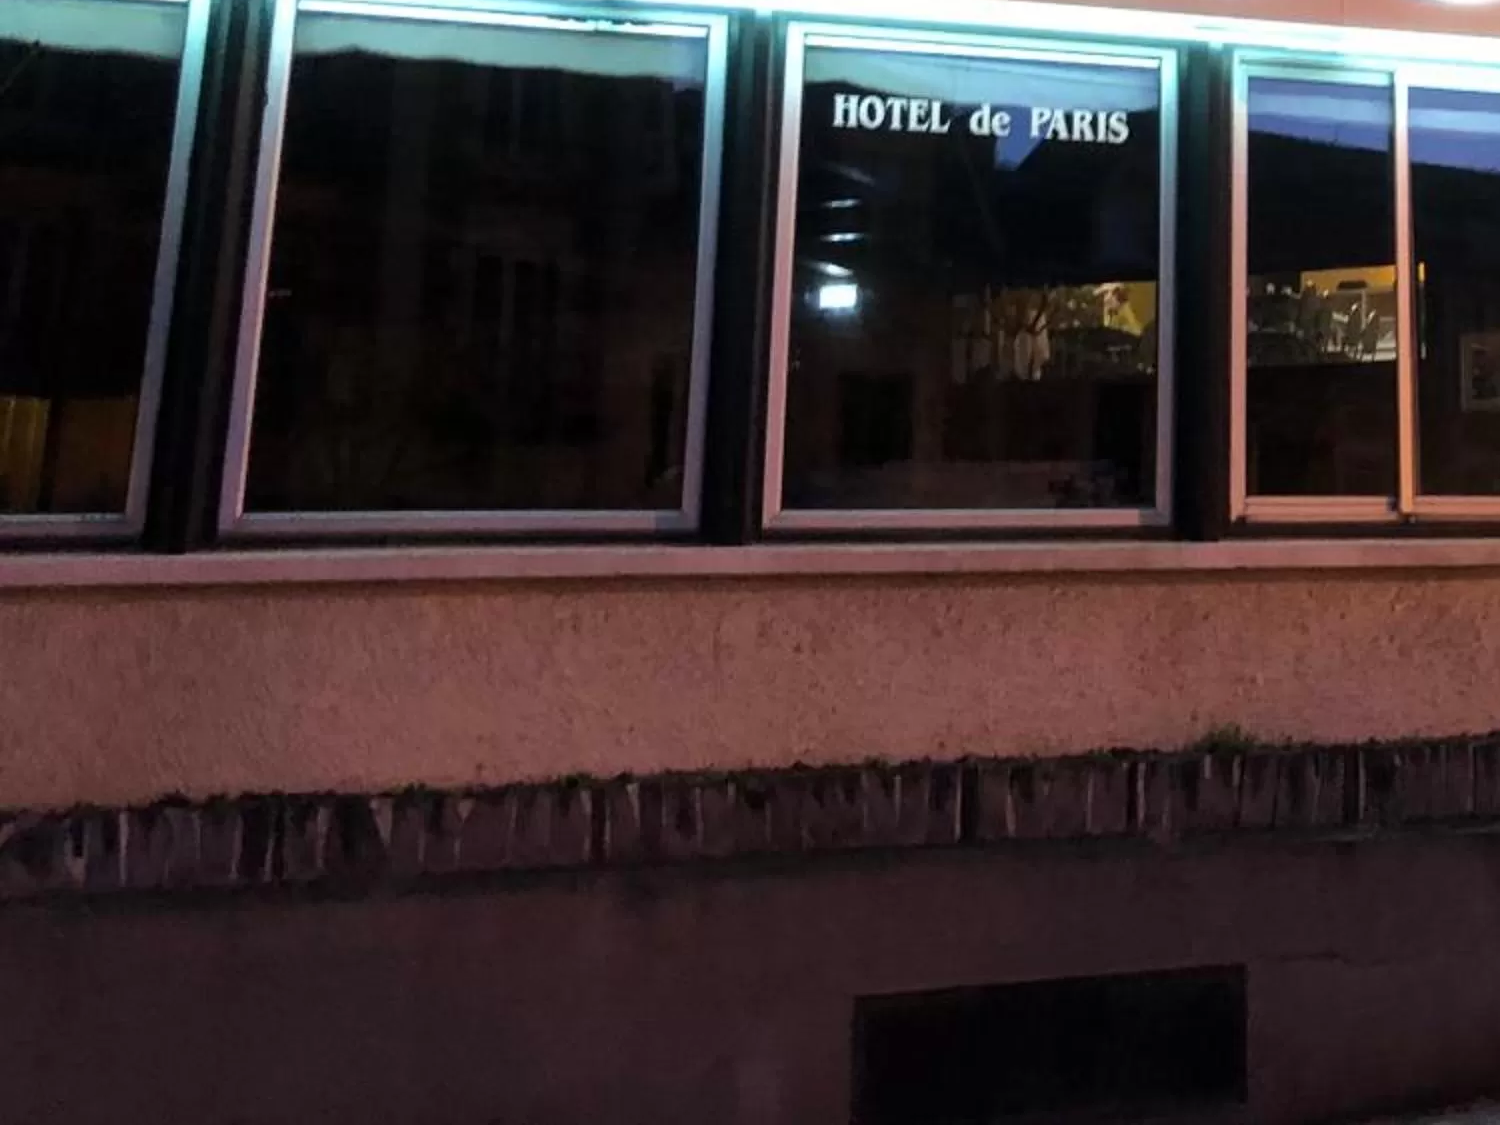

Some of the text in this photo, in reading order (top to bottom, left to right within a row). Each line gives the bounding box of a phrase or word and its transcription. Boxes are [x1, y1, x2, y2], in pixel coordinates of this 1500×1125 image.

[833, 93, 1130, 144] HOTEL de PARIS
